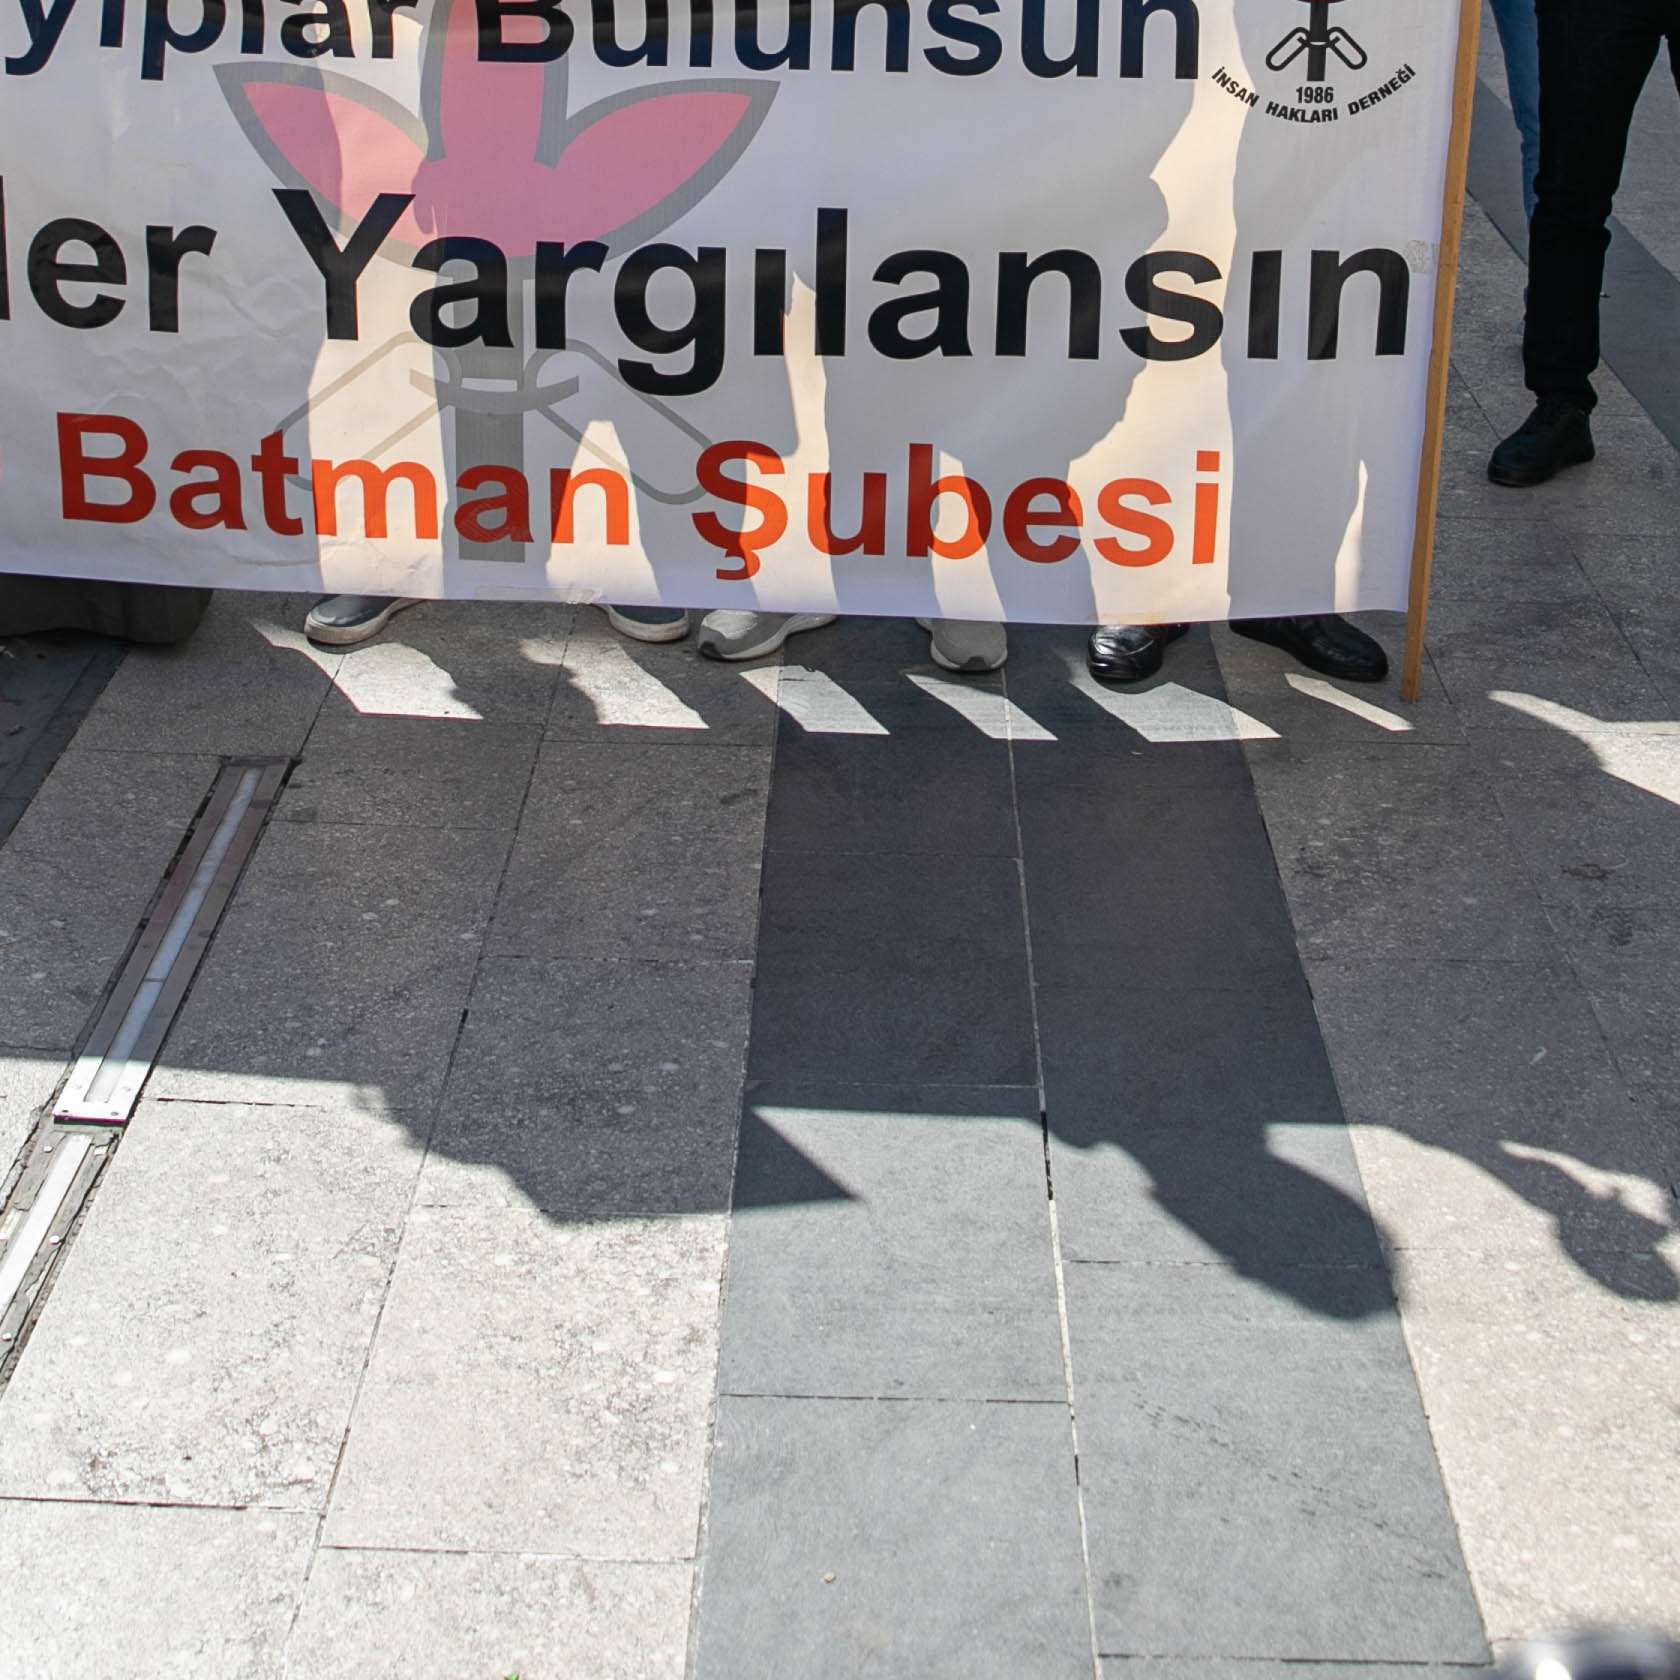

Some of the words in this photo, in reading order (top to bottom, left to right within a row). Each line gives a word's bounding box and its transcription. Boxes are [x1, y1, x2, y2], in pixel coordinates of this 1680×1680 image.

[1211, 65, 1260, 108] İNSAN
[1265, 100, 1339, 124] HAKLARI
[1347, 63, 1418, 117] DERNEĞİ
[1295, 86, 1335, 104] 1986
[273, 188, 1411, 395] Yargılansın
[59, 410, 632, 547] Batman
[691, 438, 1220, 580] Şubesi
